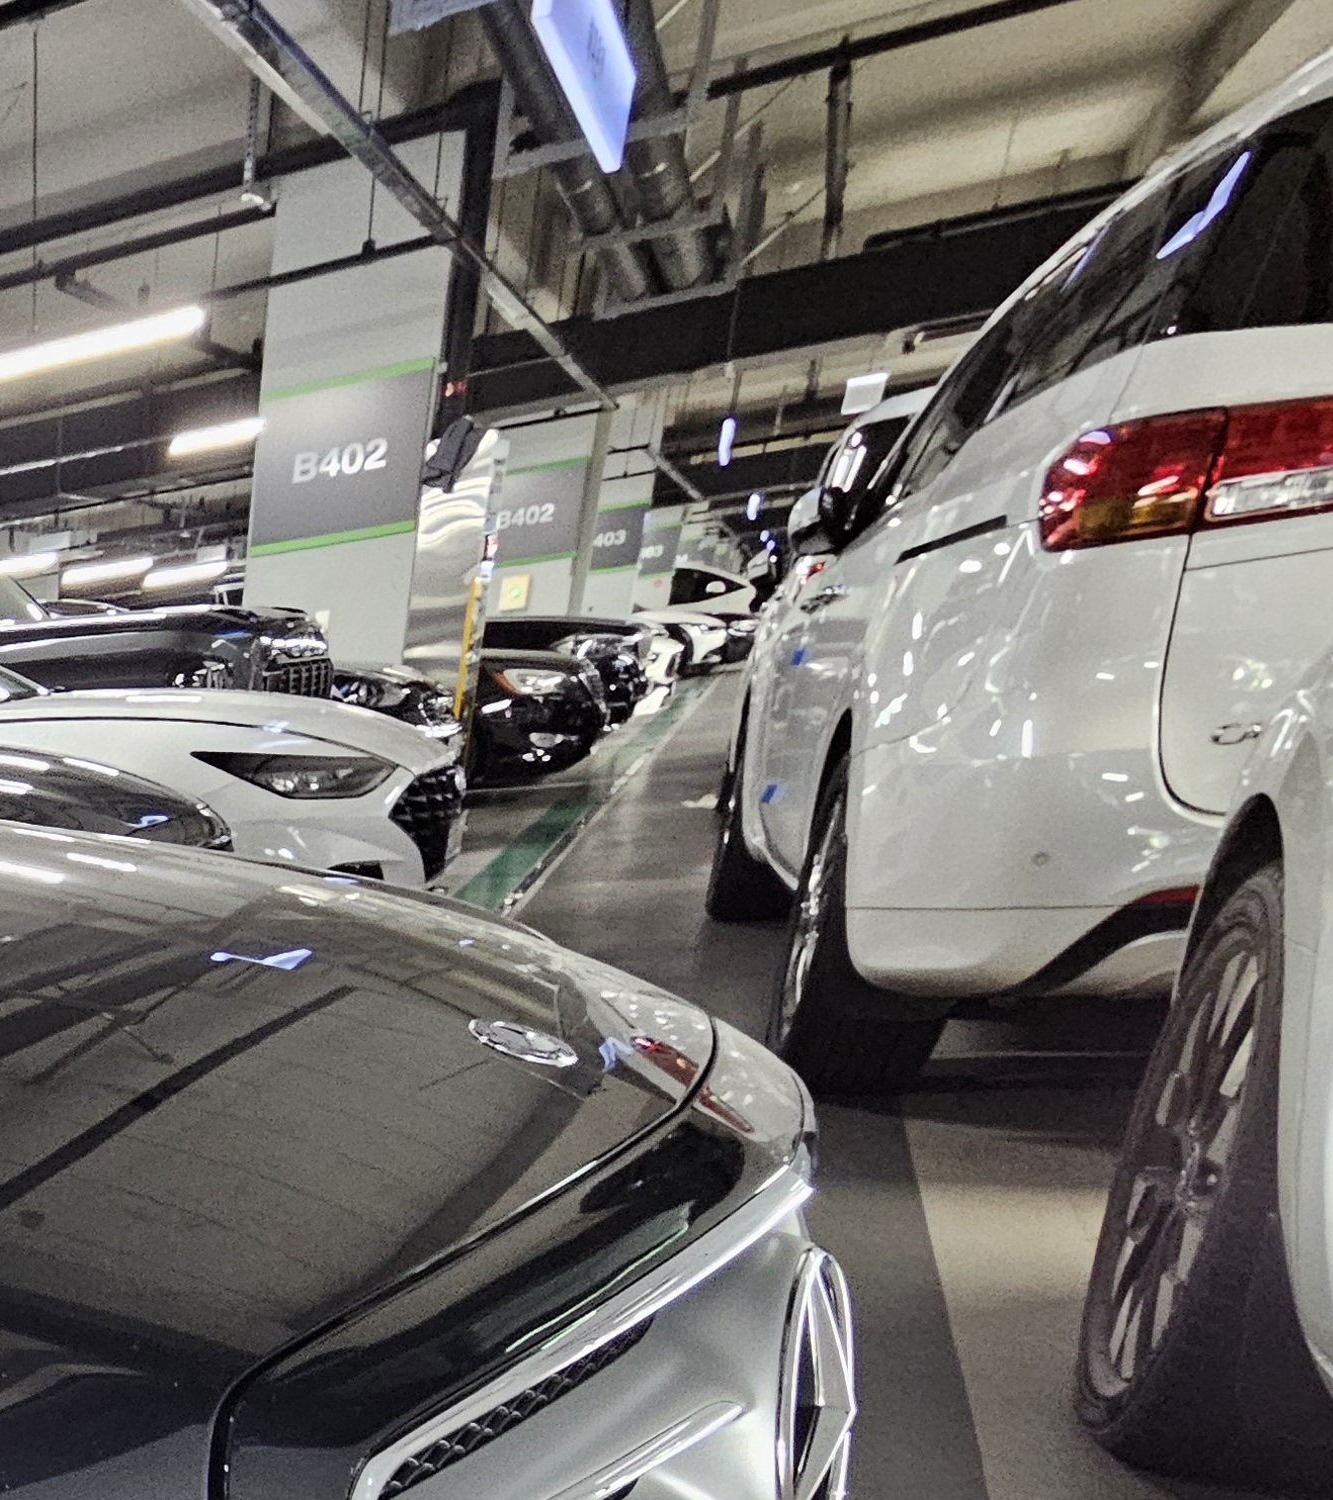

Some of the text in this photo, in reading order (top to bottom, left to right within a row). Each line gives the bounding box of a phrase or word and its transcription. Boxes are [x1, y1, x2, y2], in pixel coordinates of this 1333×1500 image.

[292, 437, 389, 484] B402
[496, 503, 555, 529] B402
[593, 529, 627, 547] 403
